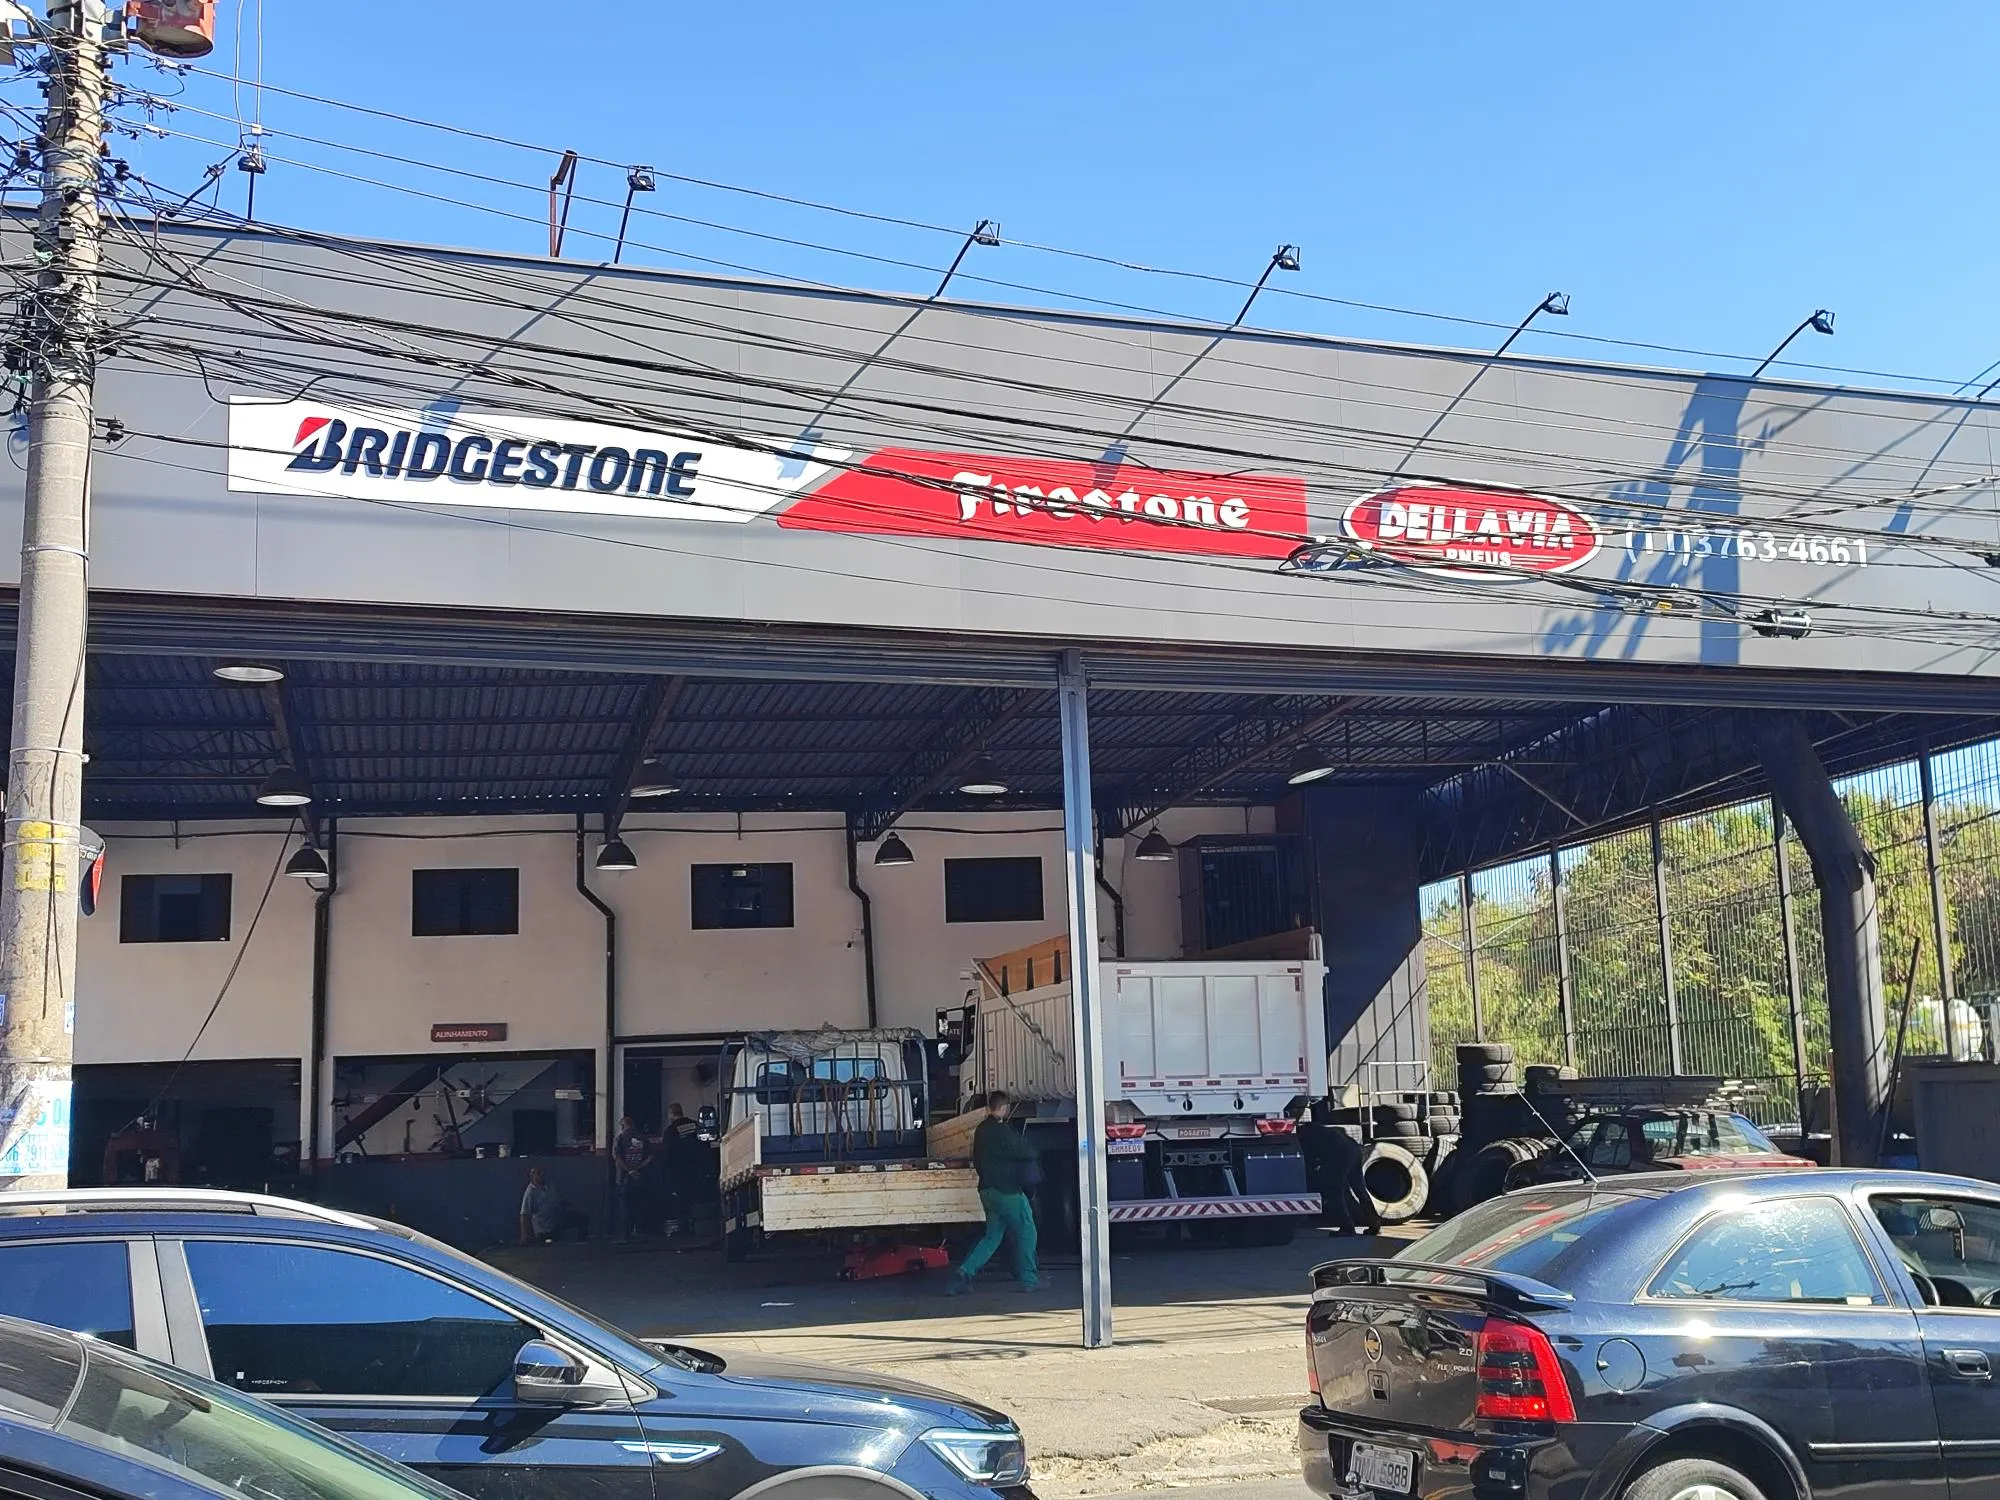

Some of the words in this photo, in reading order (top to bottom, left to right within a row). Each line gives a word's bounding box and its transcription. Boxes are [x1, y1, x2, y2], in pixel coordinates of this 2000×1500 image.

[285, 416, 702, 499] BRIDGESTONE
[952, 471, 1251, 529] Firestone
[1379, 502, 1576, 549] DELLAVIA
[435, 1030, 488, 1038] ALINHAMENTO
